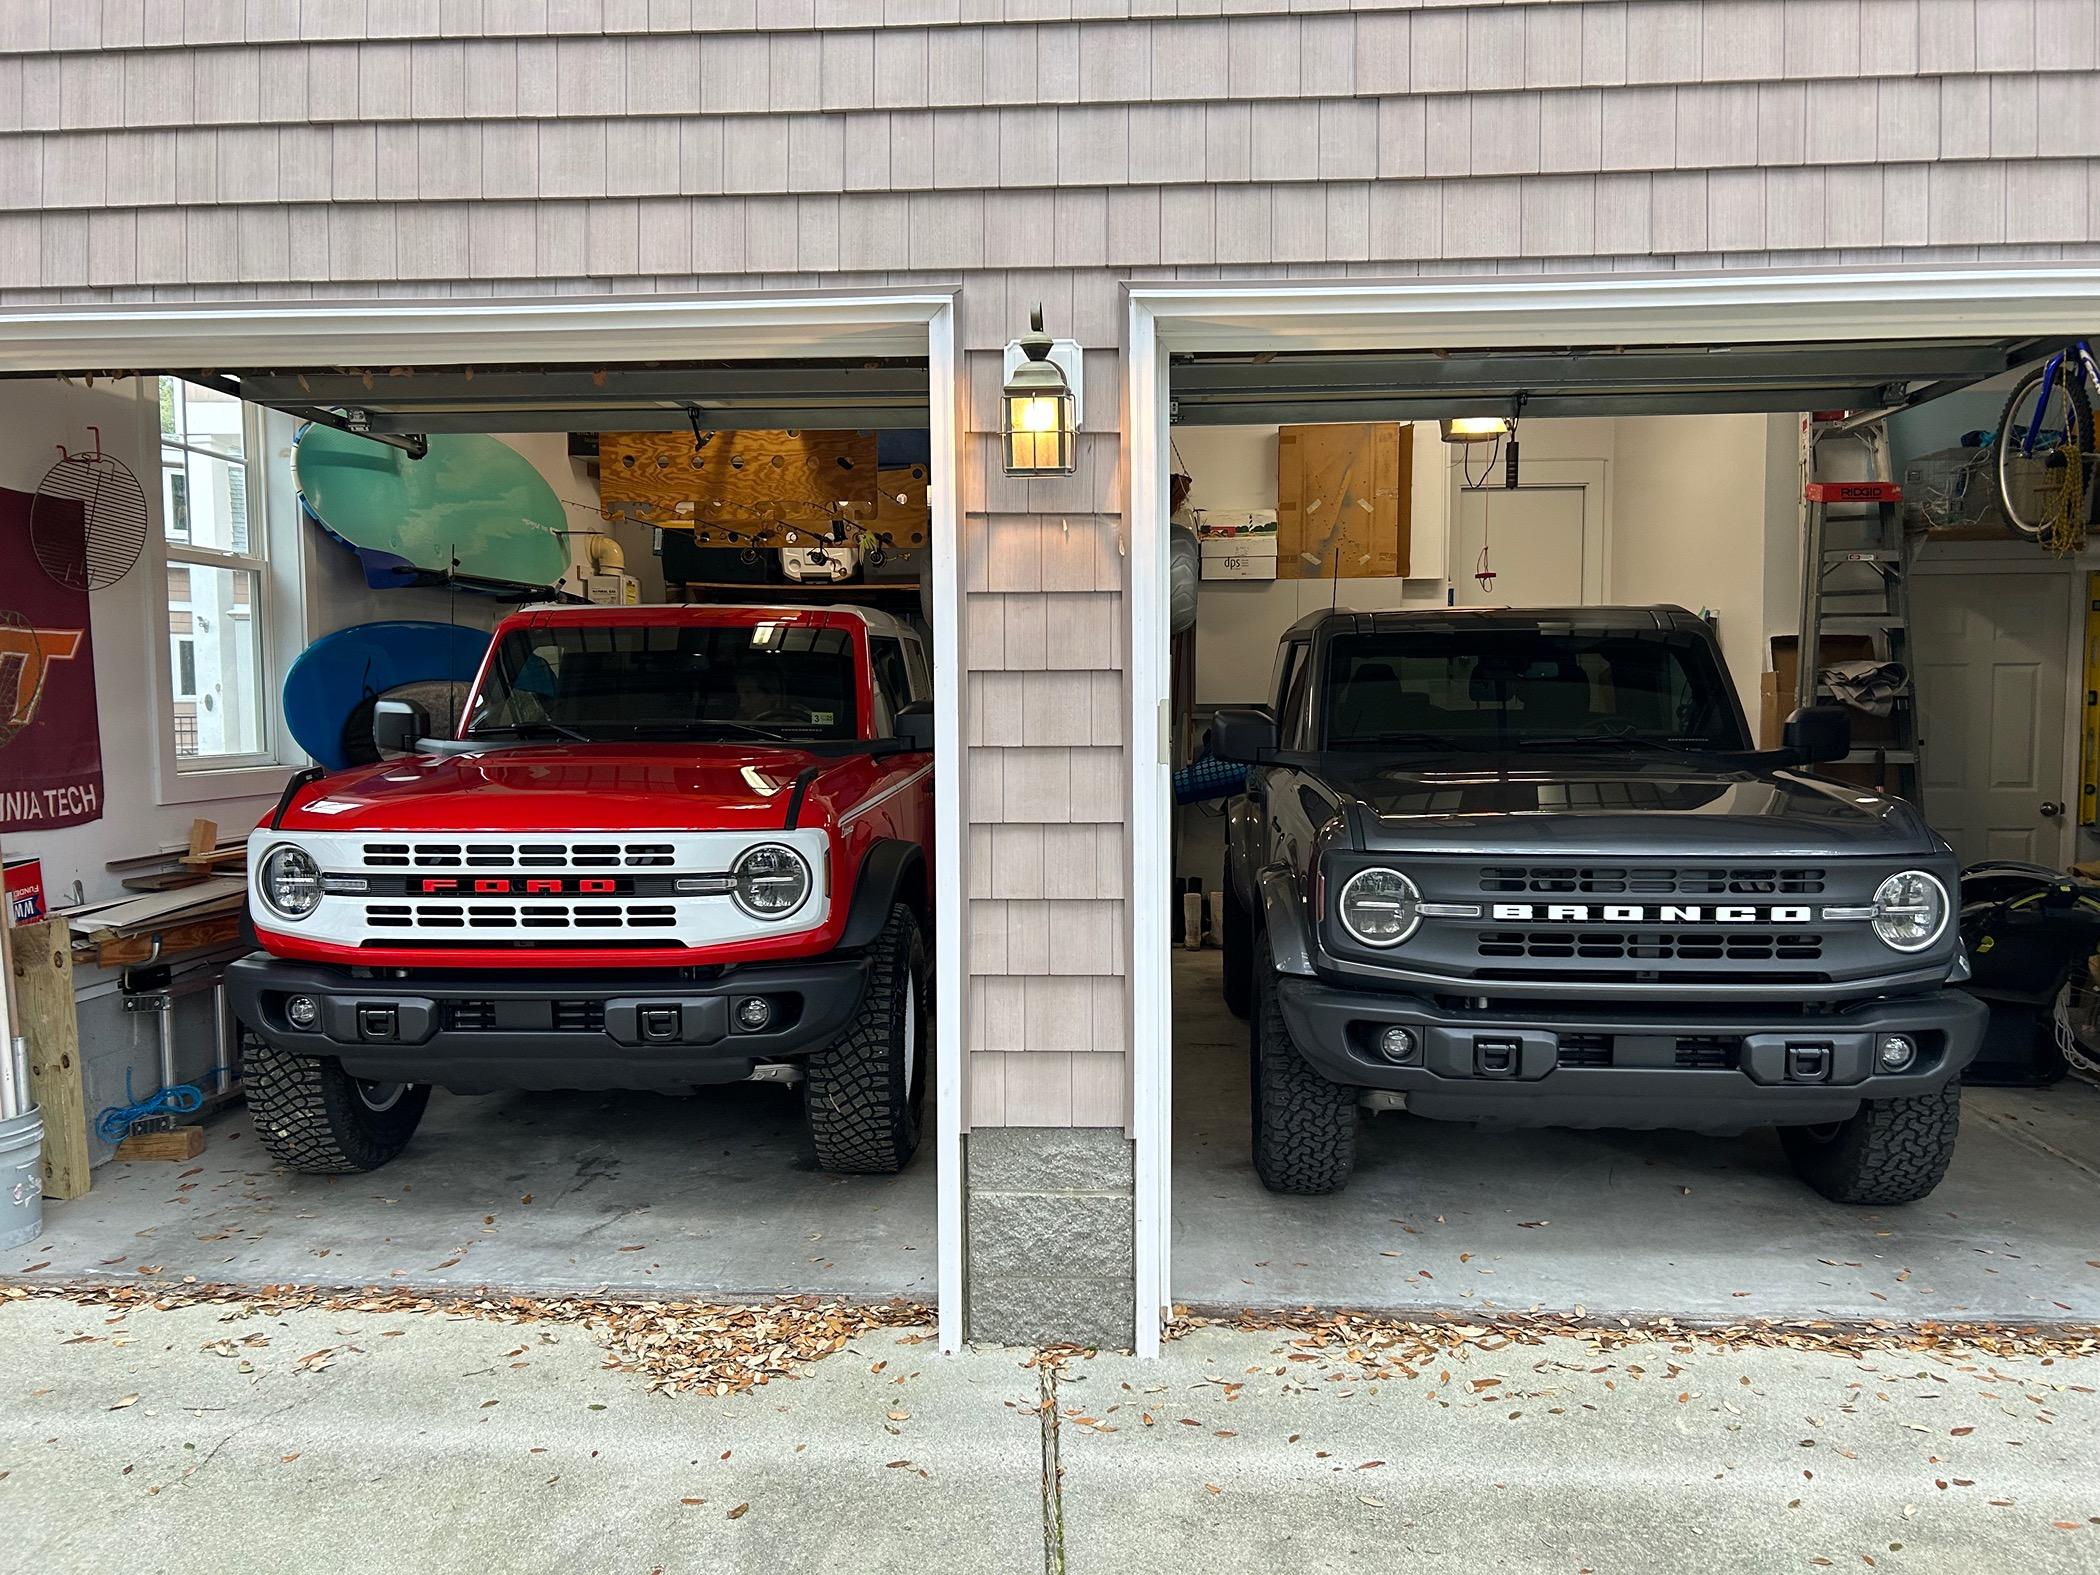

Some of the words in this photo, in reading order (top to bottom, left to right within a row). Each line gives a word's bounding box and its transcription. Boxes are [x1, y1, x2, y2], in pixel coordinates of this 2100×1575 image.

[1841, 487, 1883, 497] RIDGID
[1223, 556, 1241, 571] dps
[43, 783, 97, 818] TECH
[422, 879, 616, 893] FORD
[1493, 904, 1812, 922] BRONCO
